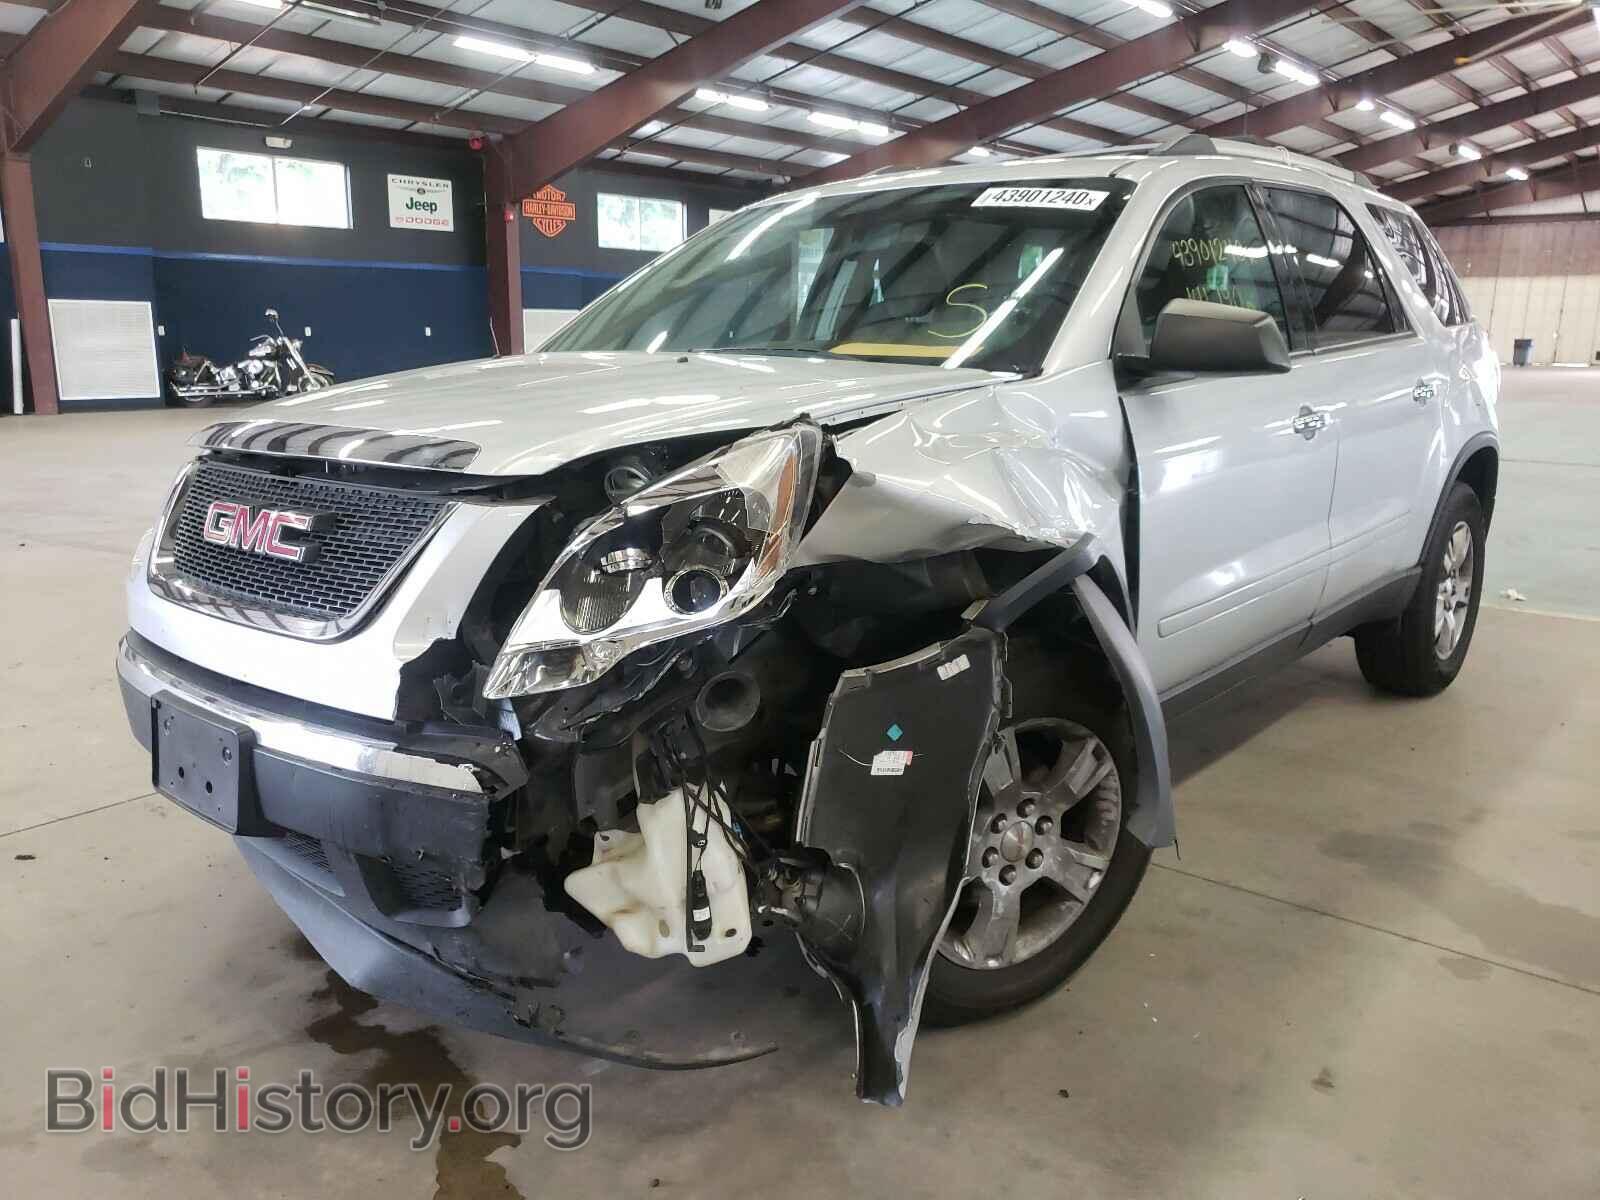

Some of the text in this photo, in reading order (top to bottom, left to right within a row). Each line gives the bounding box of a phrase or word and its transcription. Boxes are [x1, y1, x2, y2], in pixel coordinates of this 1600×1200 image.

[391, 178, 449, 188] CHRYSLER
[535, 190, 564, 201] MOTOR
[405, 196, 438, 215] Jeep
[524, 202, 574, 217] HARLEY-DAVIDSON
[405, 216, 449, 226] DODGE
[535, 218, 565, 233] CYCLES
[927, 283, 988, 338] S
[204, 501, 313, 562] GMC
